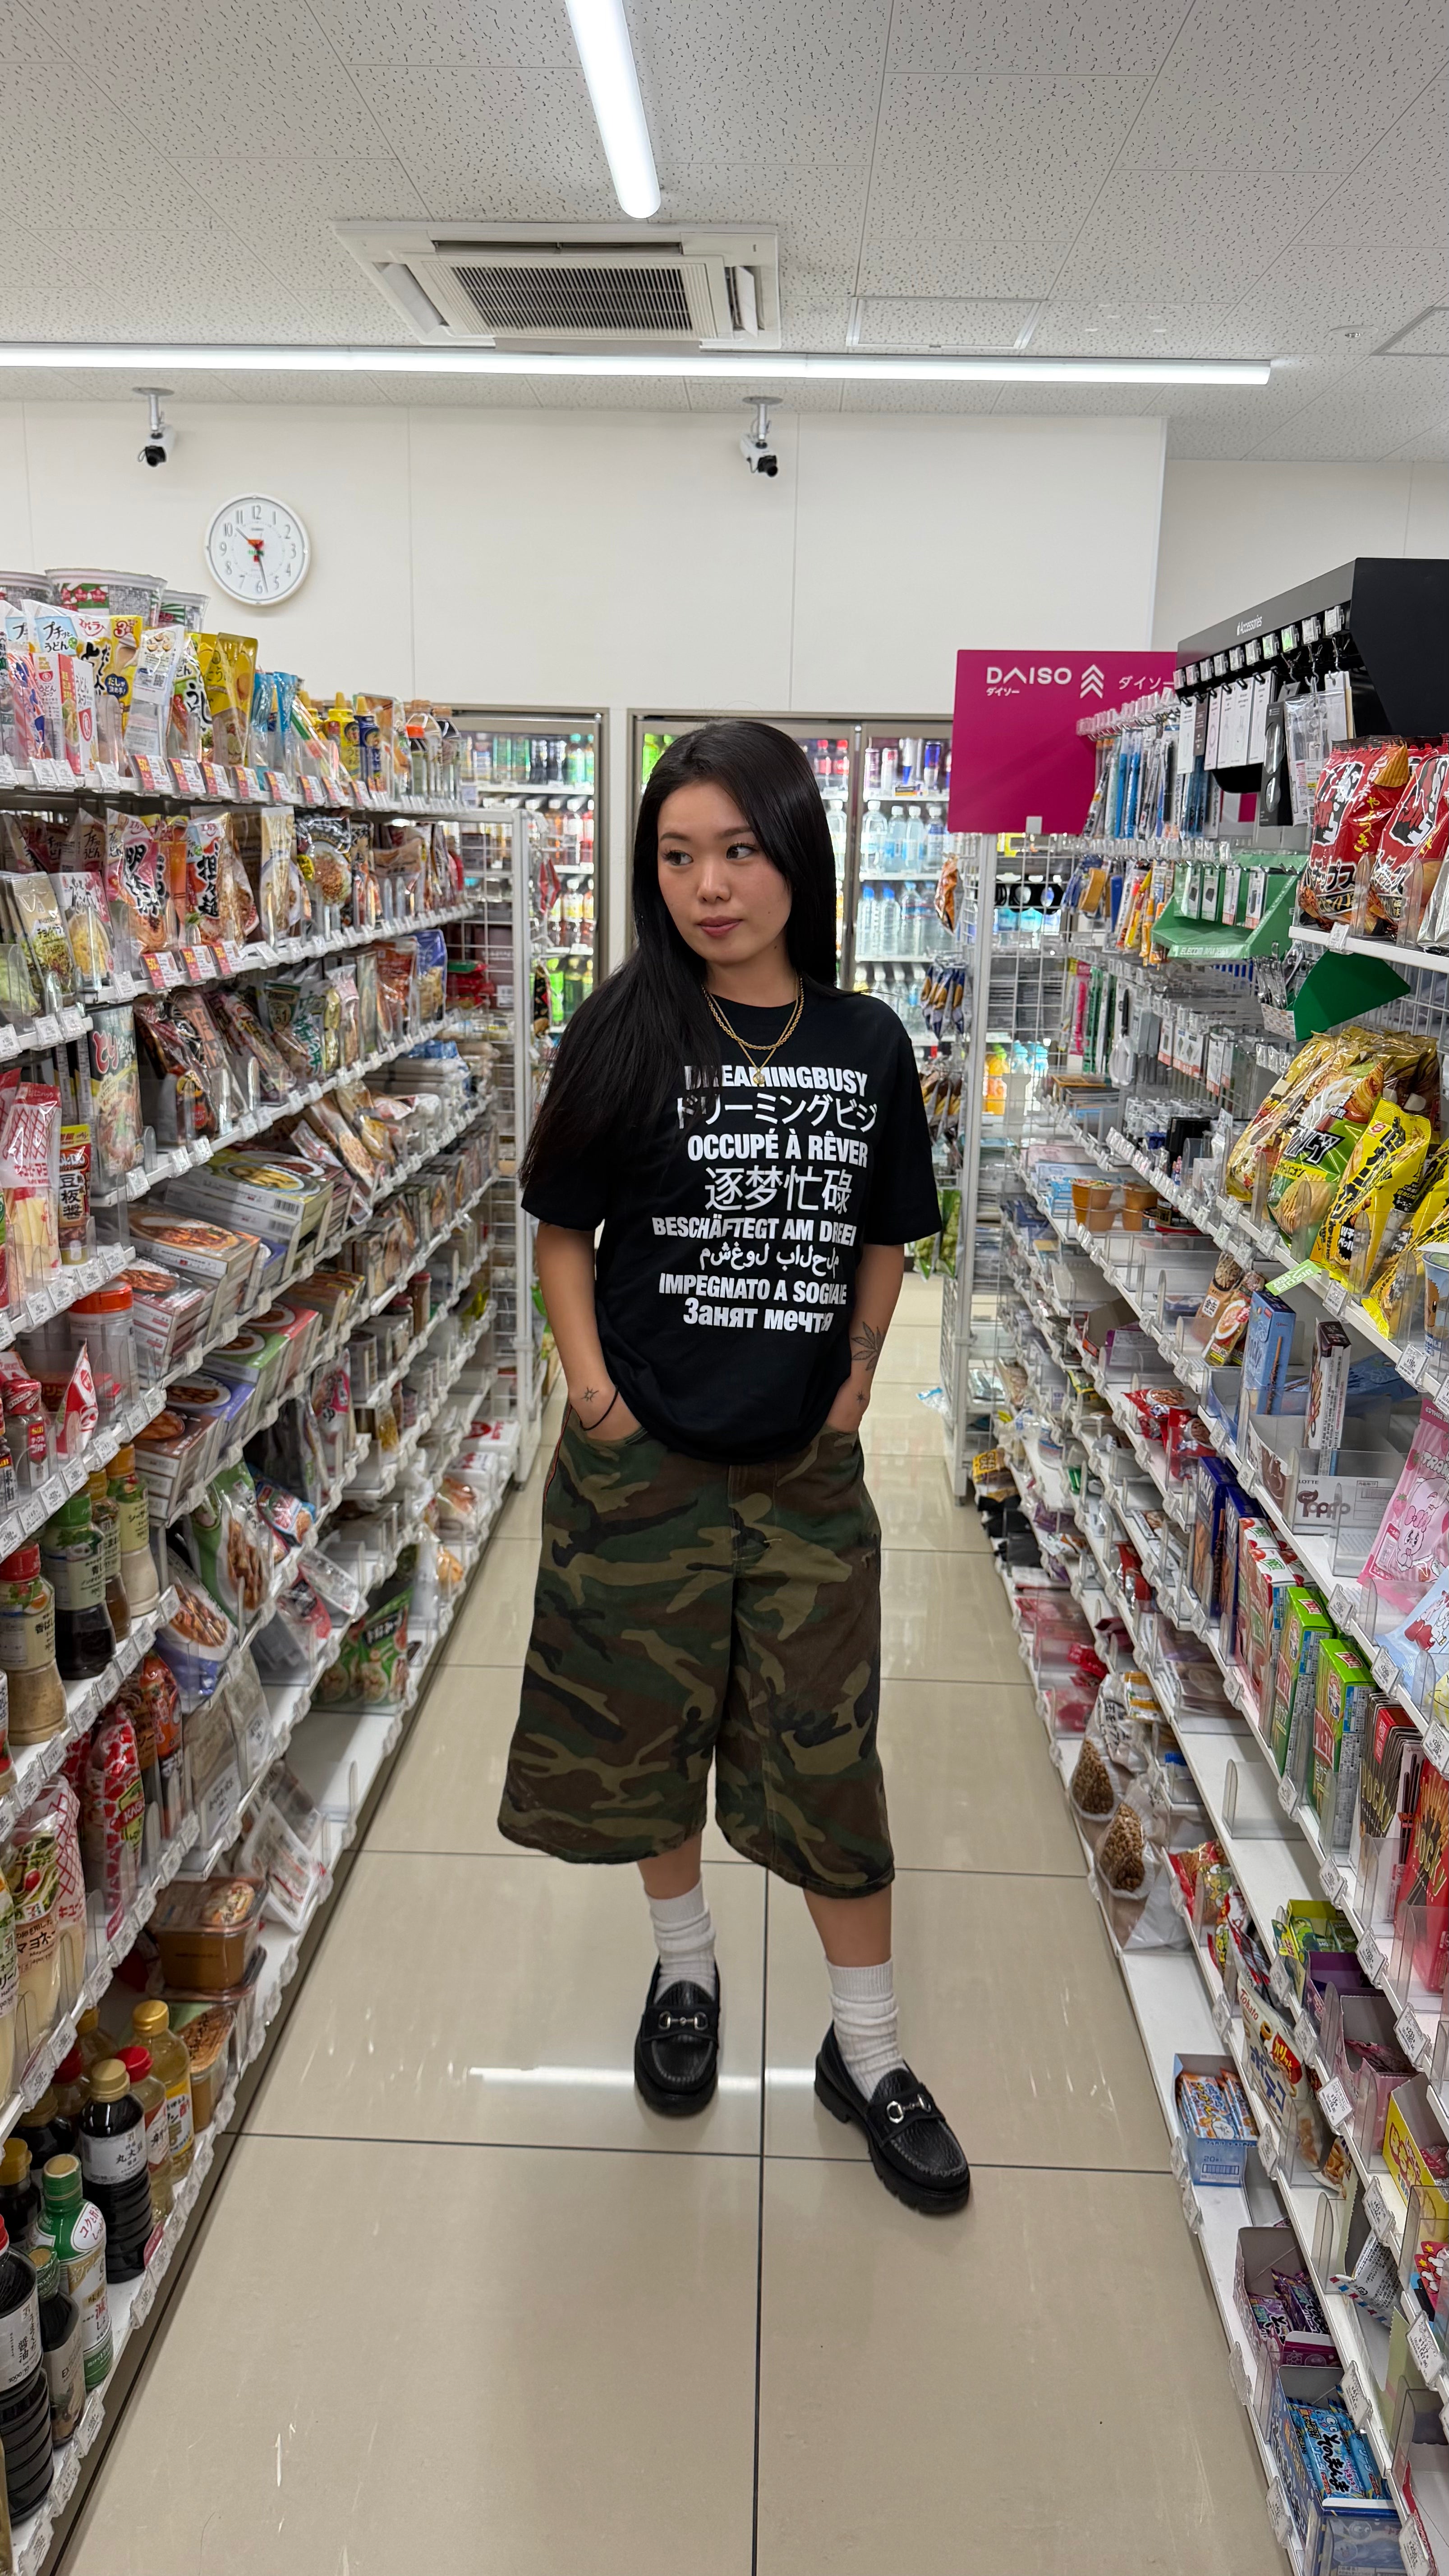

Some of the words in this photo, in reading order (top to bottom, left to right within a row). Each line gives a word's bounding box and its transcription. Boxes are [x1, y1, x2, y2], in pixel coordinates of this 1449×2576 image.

[236, 510, 243, 524] 11
[252, 505, 262, 520] 12
[272, 511, 276, 524] 1
[225, 522, 233, 537] 10
[285, 524, 290, 539] 2
[219, 542, 227, 556] 9
[290, 543, 296, 559] 3
[225, 561, 232, 575] 8
[286, 563, 291, 576] 4
[239, 575, 245, 590] 7
[255, 580, 262, 594] 6
[274, 576, 279, 590] 5
[43, 621, 72, 641] プチッと
[45, 641, 69, 653] うどん
[986, 667, 1072, 685] DAISO
[1118, 676, 1175, 690] ダイソー
[986, 686, 1021, 697] ダイソー
[688, 1129, 779, 1161] OCCUPÉ
[785, 1129, 800, 1159] À
[808, 1131, 868, 1168] RÊVER
[704, 1165, 853, 1215] 逐梦忙碌
[782, 1219, 814, 1241] AM
[659, 1273, 771, 1300] IMPEGNATO
[774, 1279, 787, 1302] A
[683, 1297, 758, 1329] Занят
[1297, 1490, 1351, 1518] Toppo
[1413, 1817, 1447, 1896] POCKY
[17, 1930, 56, 1953] マヨネー
[1241, 1988, 1259, 2021] Tohato
[1317, 2433, 1351, 2494] そのまんま
